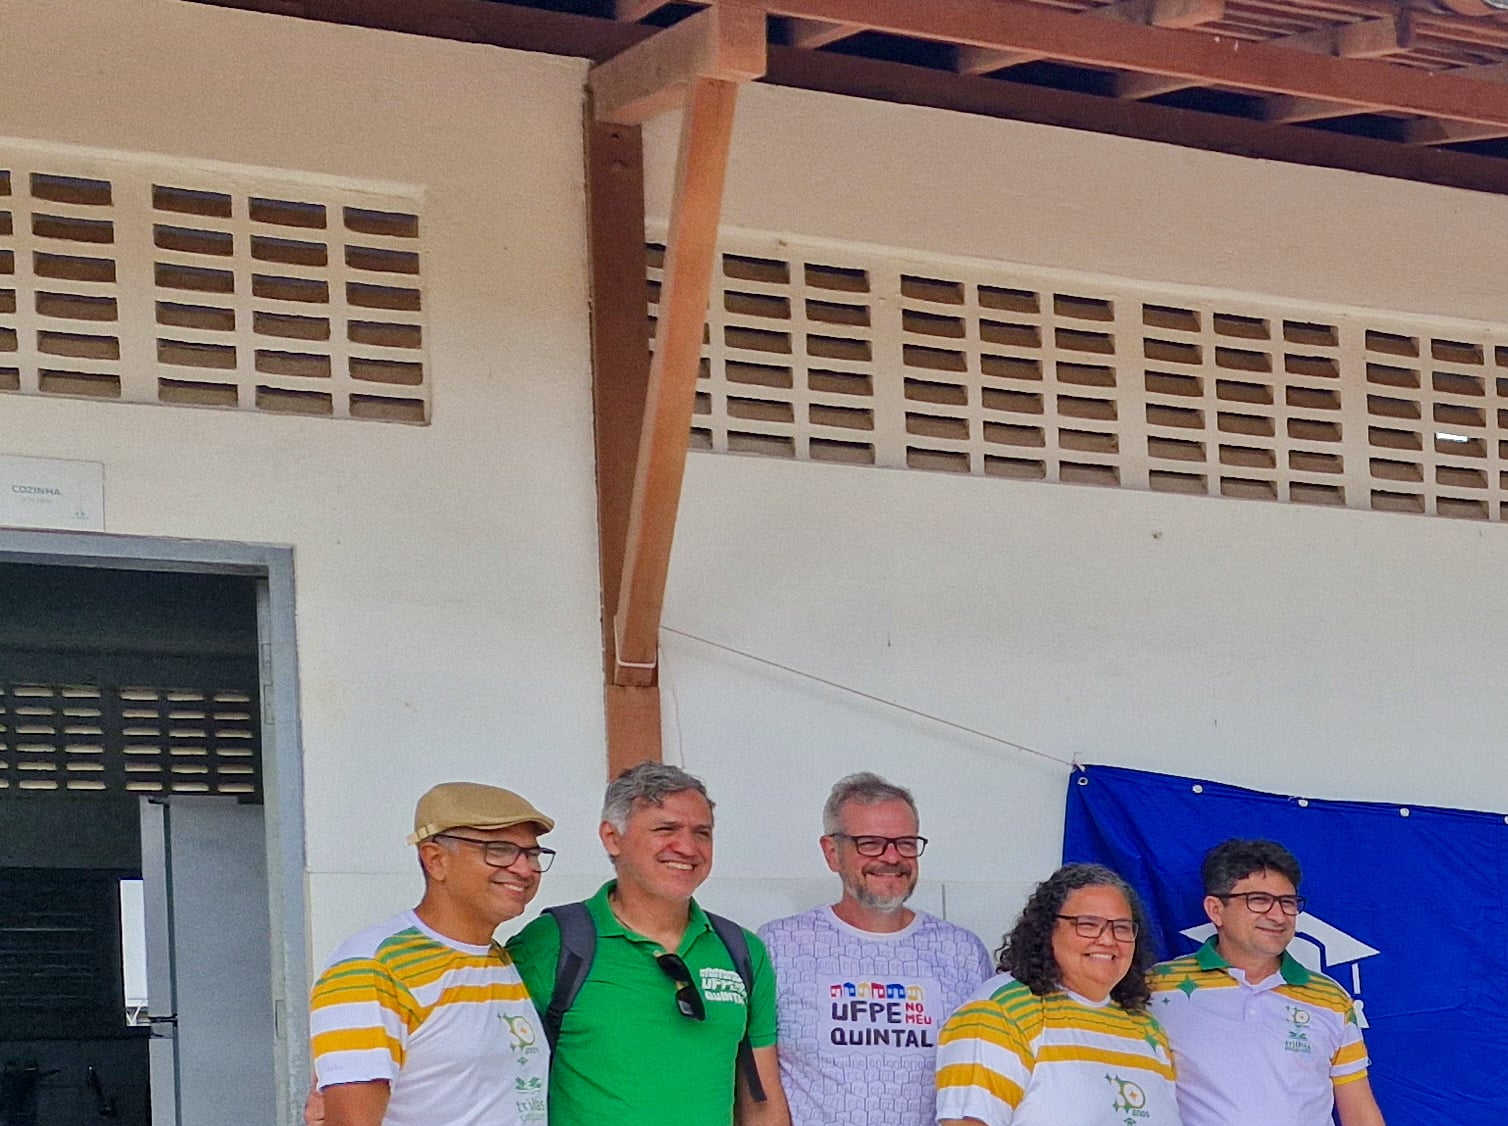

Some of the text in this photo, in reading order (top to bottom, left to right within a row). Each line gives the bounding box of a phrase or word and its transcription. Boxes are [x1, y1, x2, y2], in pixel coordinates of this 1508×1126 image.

[12, 485, 62, 496] COZINHA
[832, 1000, 924, 1023] UFPE NO
[905, 1014, 932, 1025] MEU
[830, 1027, 934, 1048] QUINTAL
